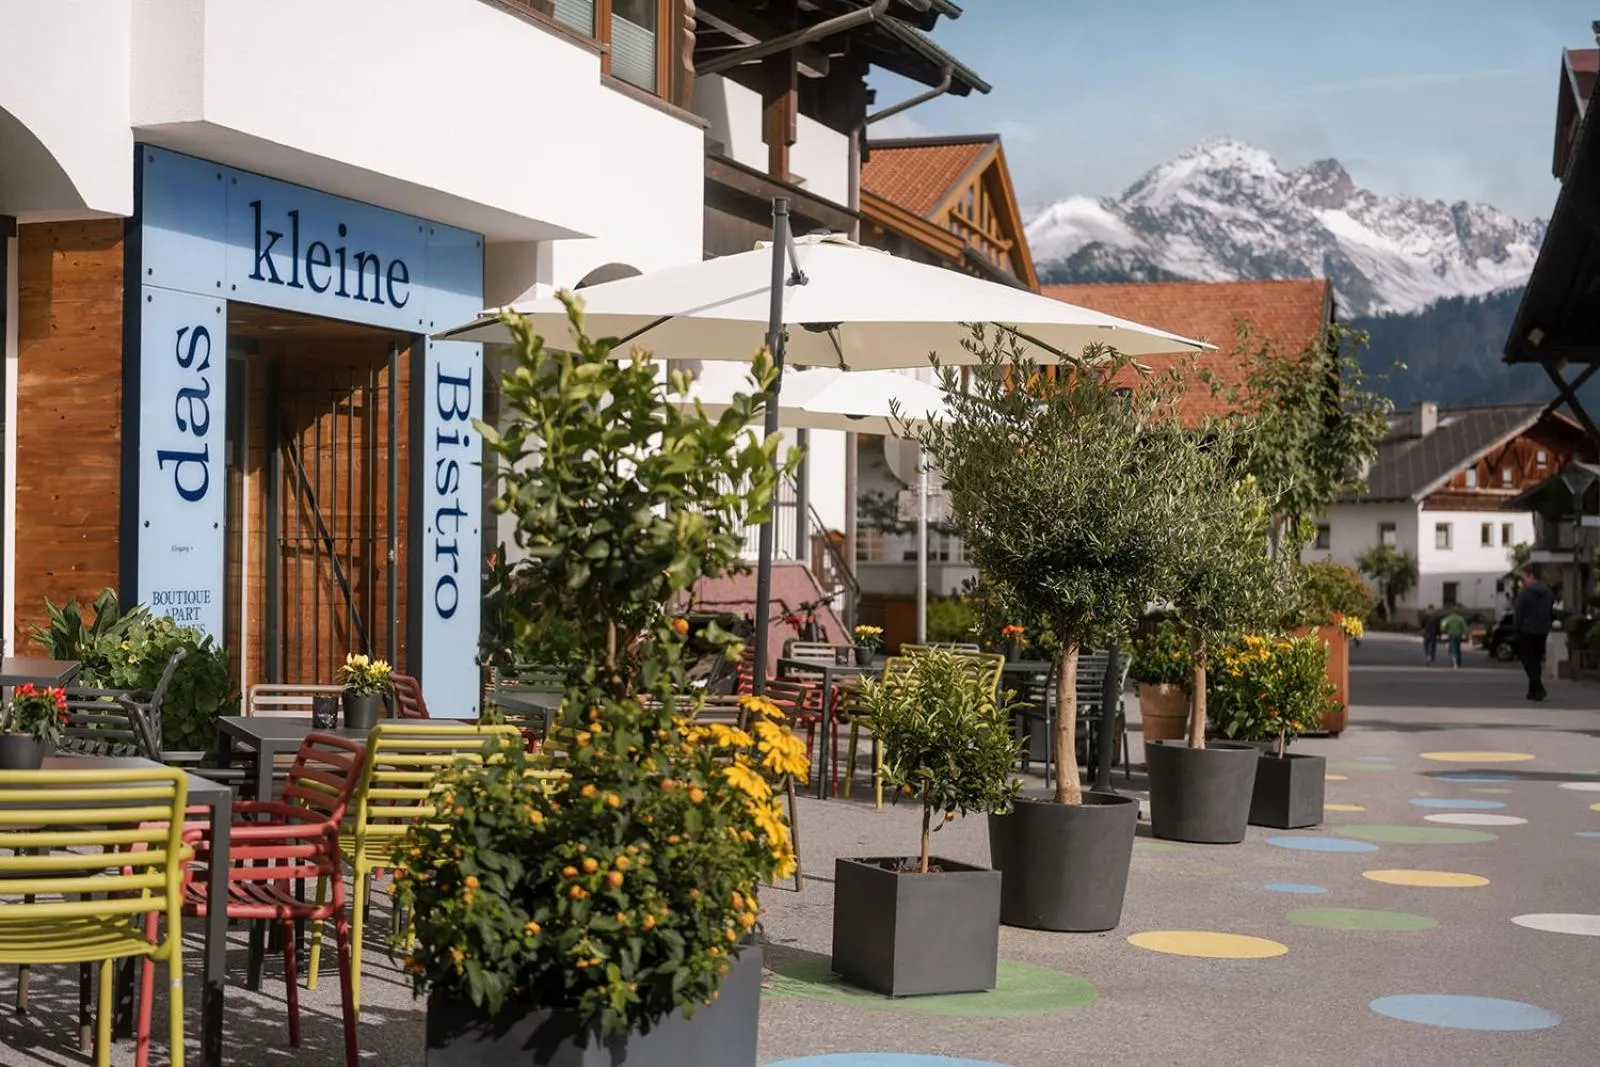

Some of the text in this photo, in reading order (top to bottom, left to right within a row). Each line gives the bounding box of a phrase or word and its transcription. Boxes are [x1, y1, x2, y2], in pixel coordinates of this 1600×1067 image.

[248, 200, 410, 309] kleine
[157, 325, 212, 502] das
[435, 362, 472, 620] Bistro
[152, 590, 211, 606] BOUTIQUE
